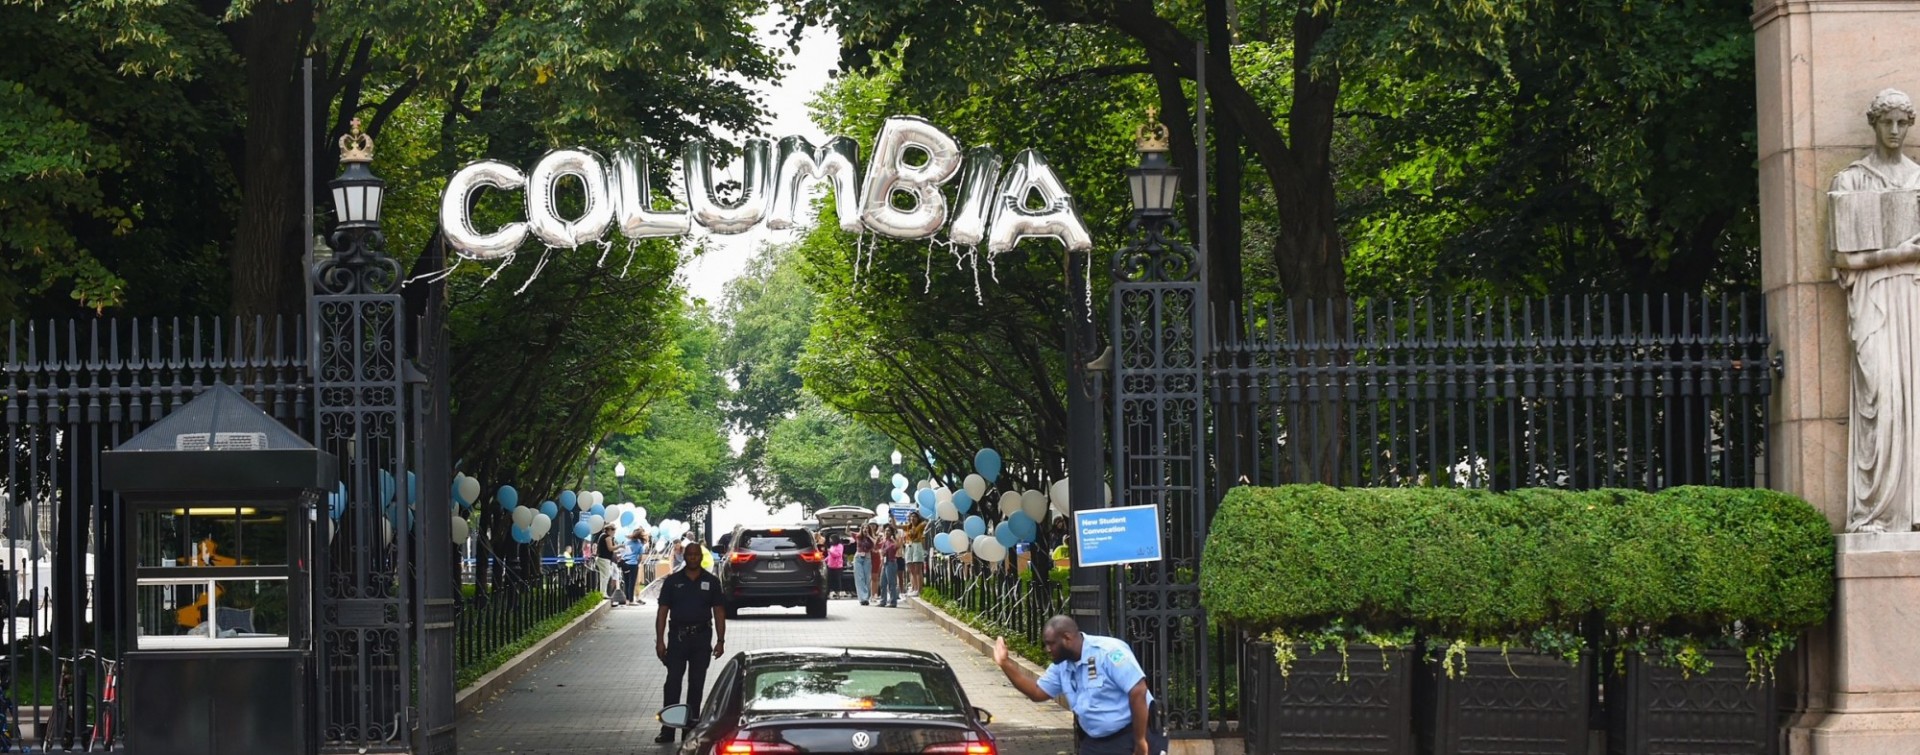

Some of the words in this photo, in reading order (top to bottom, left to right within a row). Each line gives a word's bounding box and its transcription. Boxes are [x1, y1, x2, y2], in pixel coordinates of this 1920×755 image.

[441, 116, 1092, 260] COLUMBIA
[1099, 517, 1126, 525] Student
[1083, 526, 1126, 535] Convocation
[852, 732, 870, 749] VW
